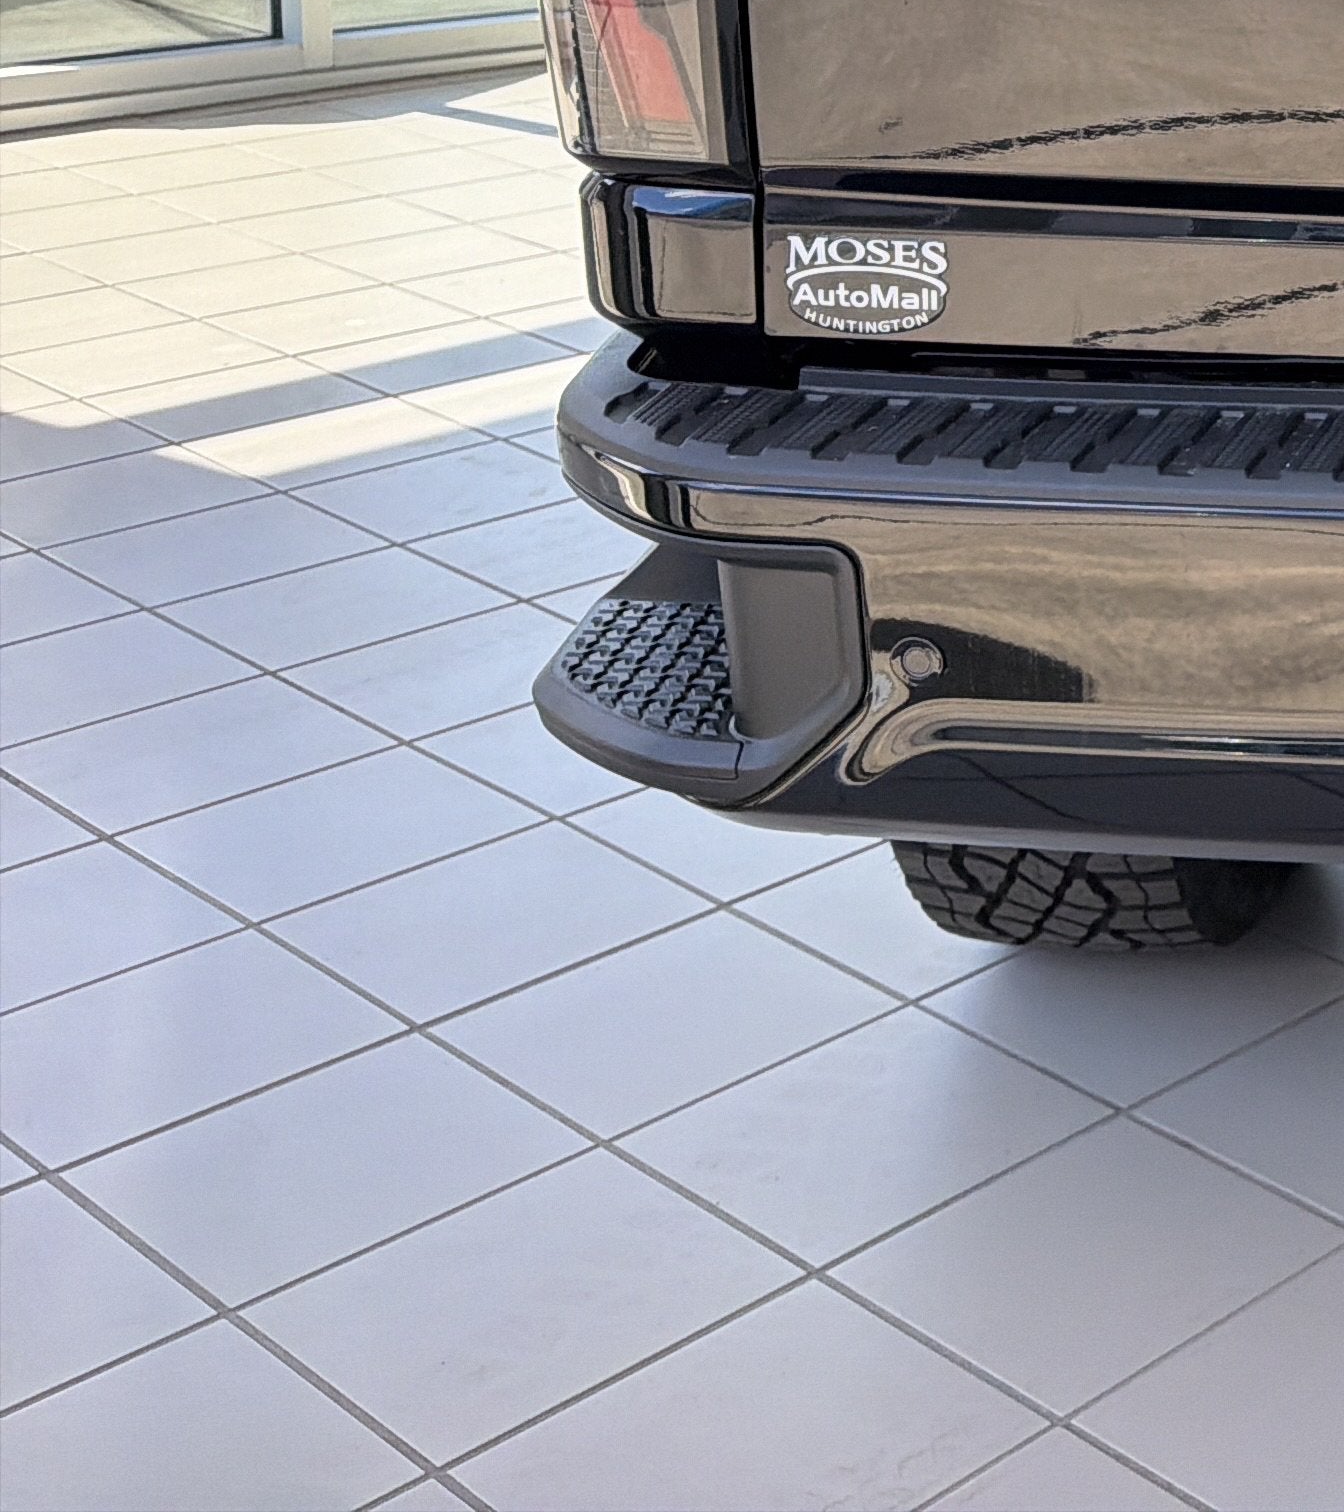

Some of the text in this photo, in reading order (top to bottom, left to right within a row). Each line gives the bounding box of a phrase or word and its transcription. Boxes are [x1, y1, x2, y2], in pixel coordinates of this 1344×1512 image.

[785, 235, 948, 275] MOSES
[792, 282, 939, 311] AutoMall
[803, 307, 930, 334] HUNTINGTON
